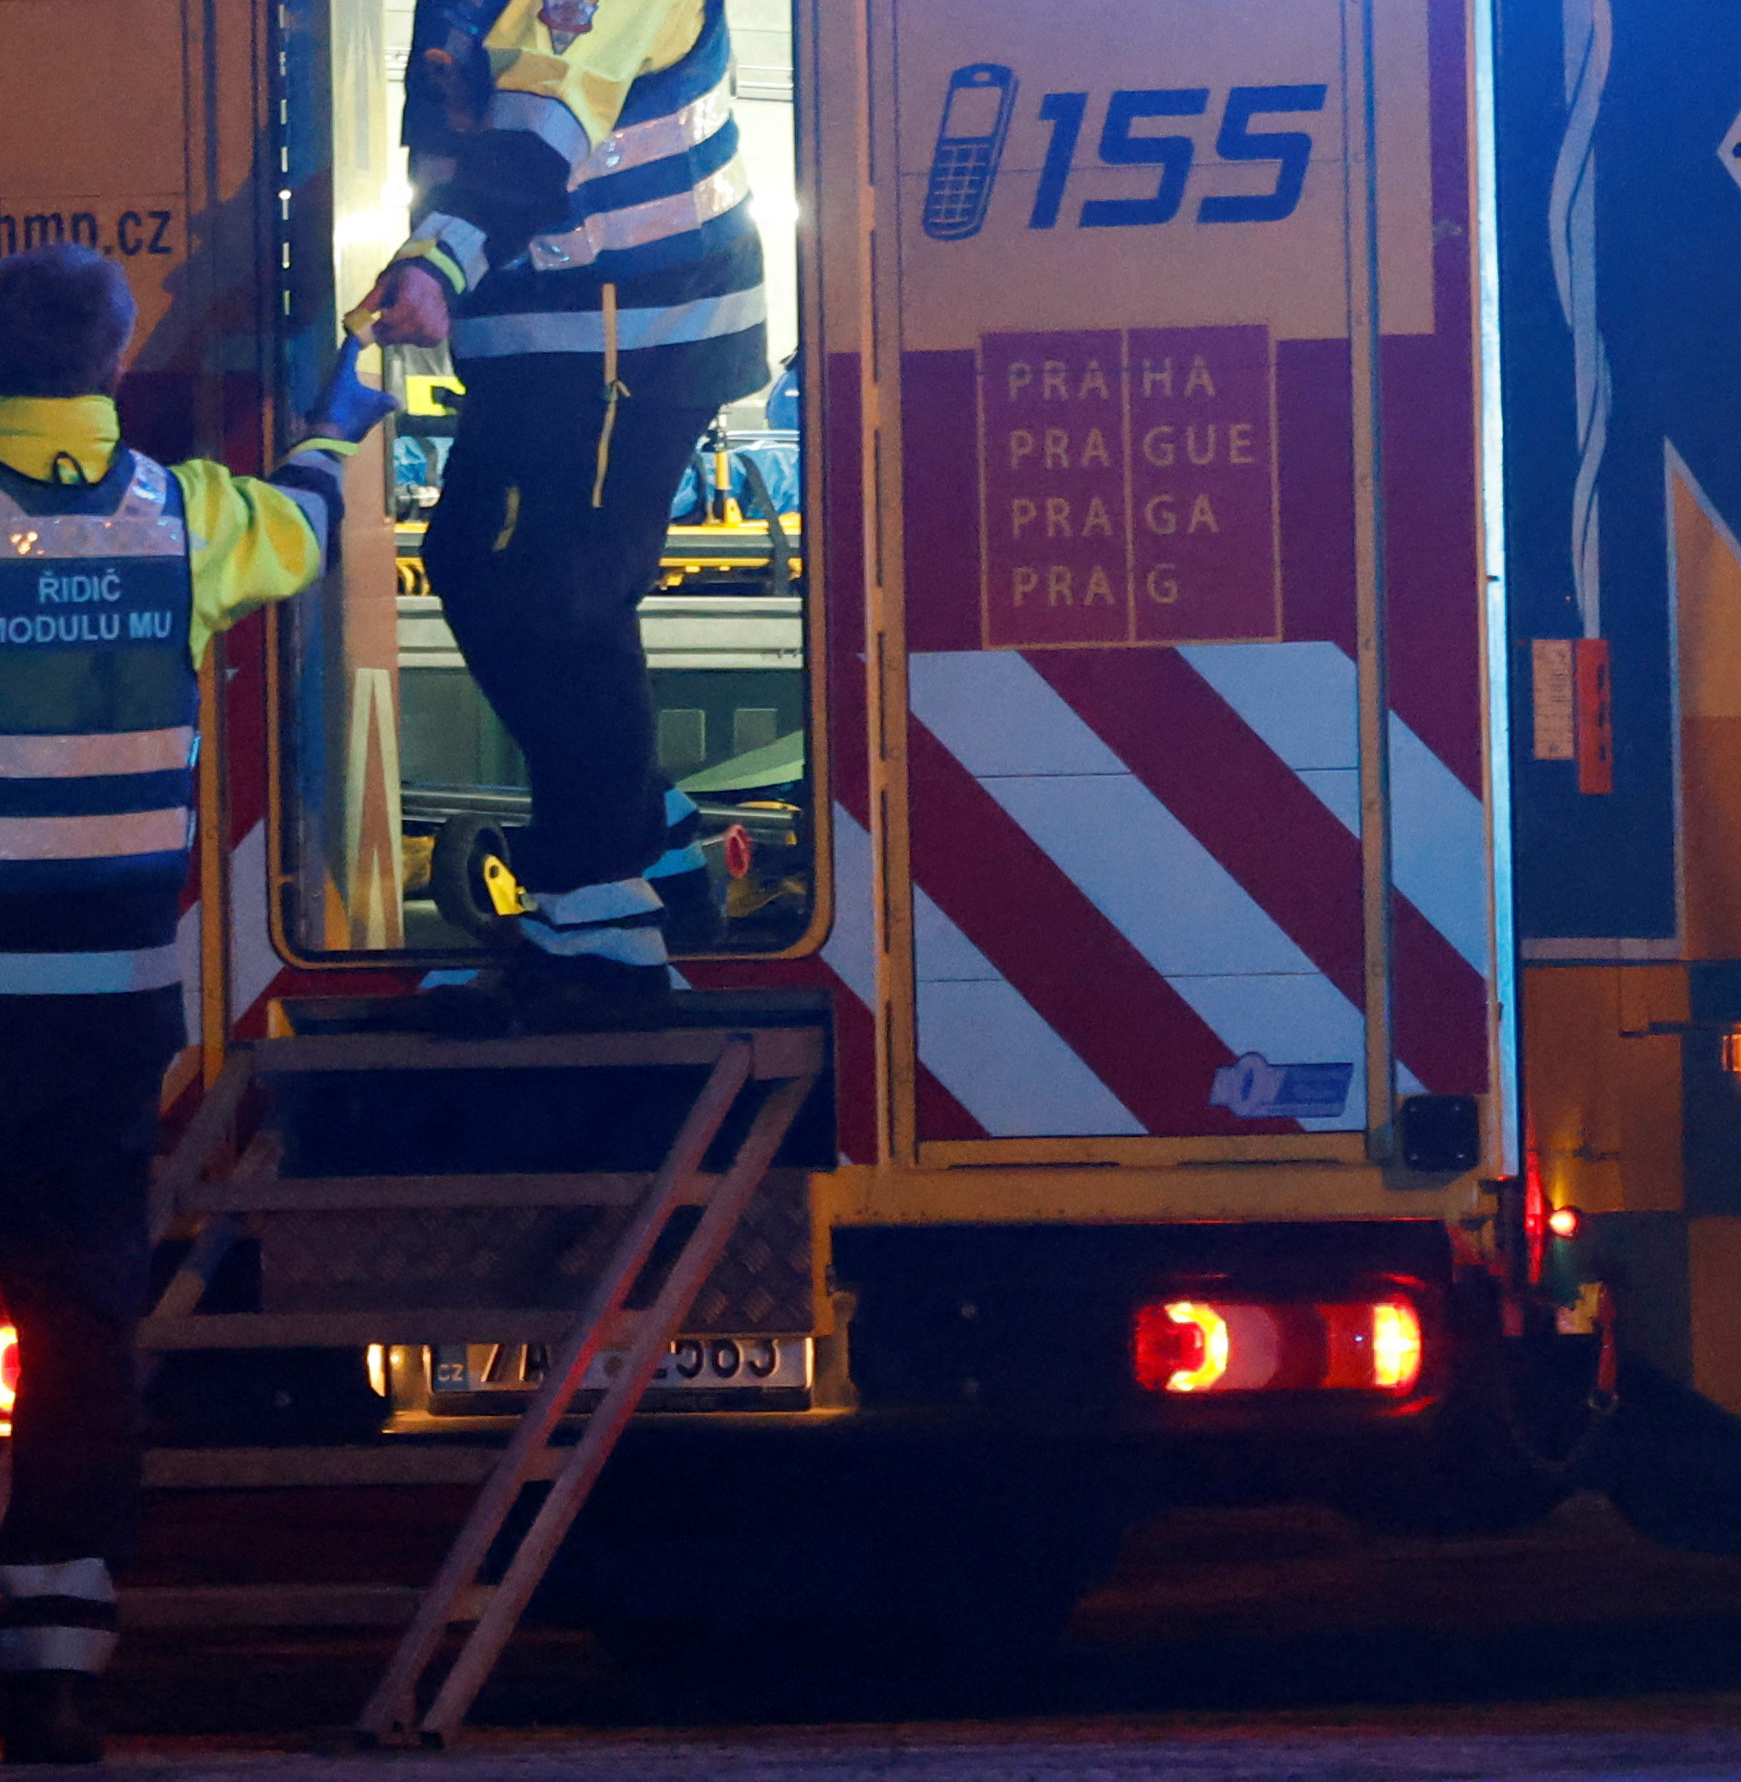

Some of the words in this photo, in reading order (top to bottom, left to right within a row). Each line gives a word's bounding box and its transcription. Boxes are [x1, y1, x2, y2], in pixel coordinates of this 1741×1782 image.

[1027, 84, 1327, 229] 155
[38, 568, 121, 604] ŘIDIČ
[128, 611, 172, 639] MU
[437, 1363, 465, 1383] CZ
